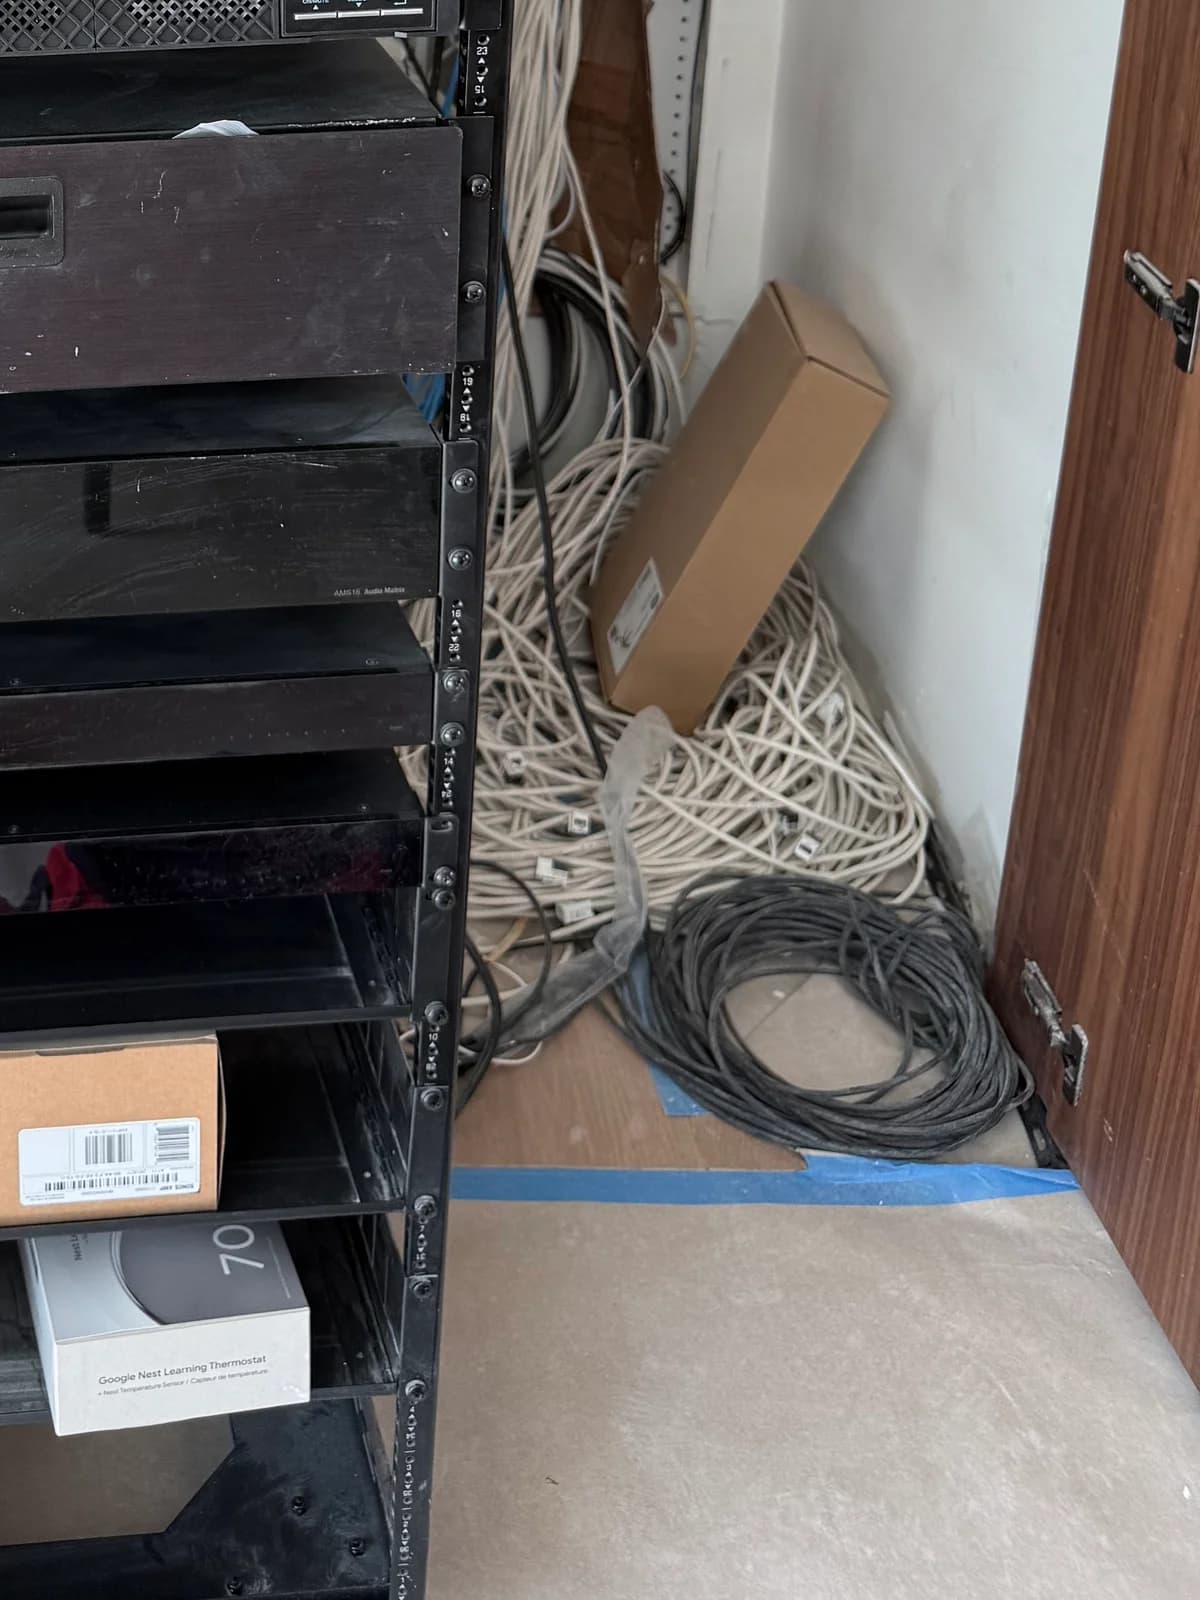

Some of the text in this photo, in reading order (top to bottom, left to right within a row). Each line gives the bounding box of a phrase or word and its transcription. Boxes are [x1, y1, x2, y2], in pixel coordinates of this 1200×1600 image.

[476, 46, 488, 56] 23
[98, 1355, 266, 1385] Google Nest Learning Thermostat
